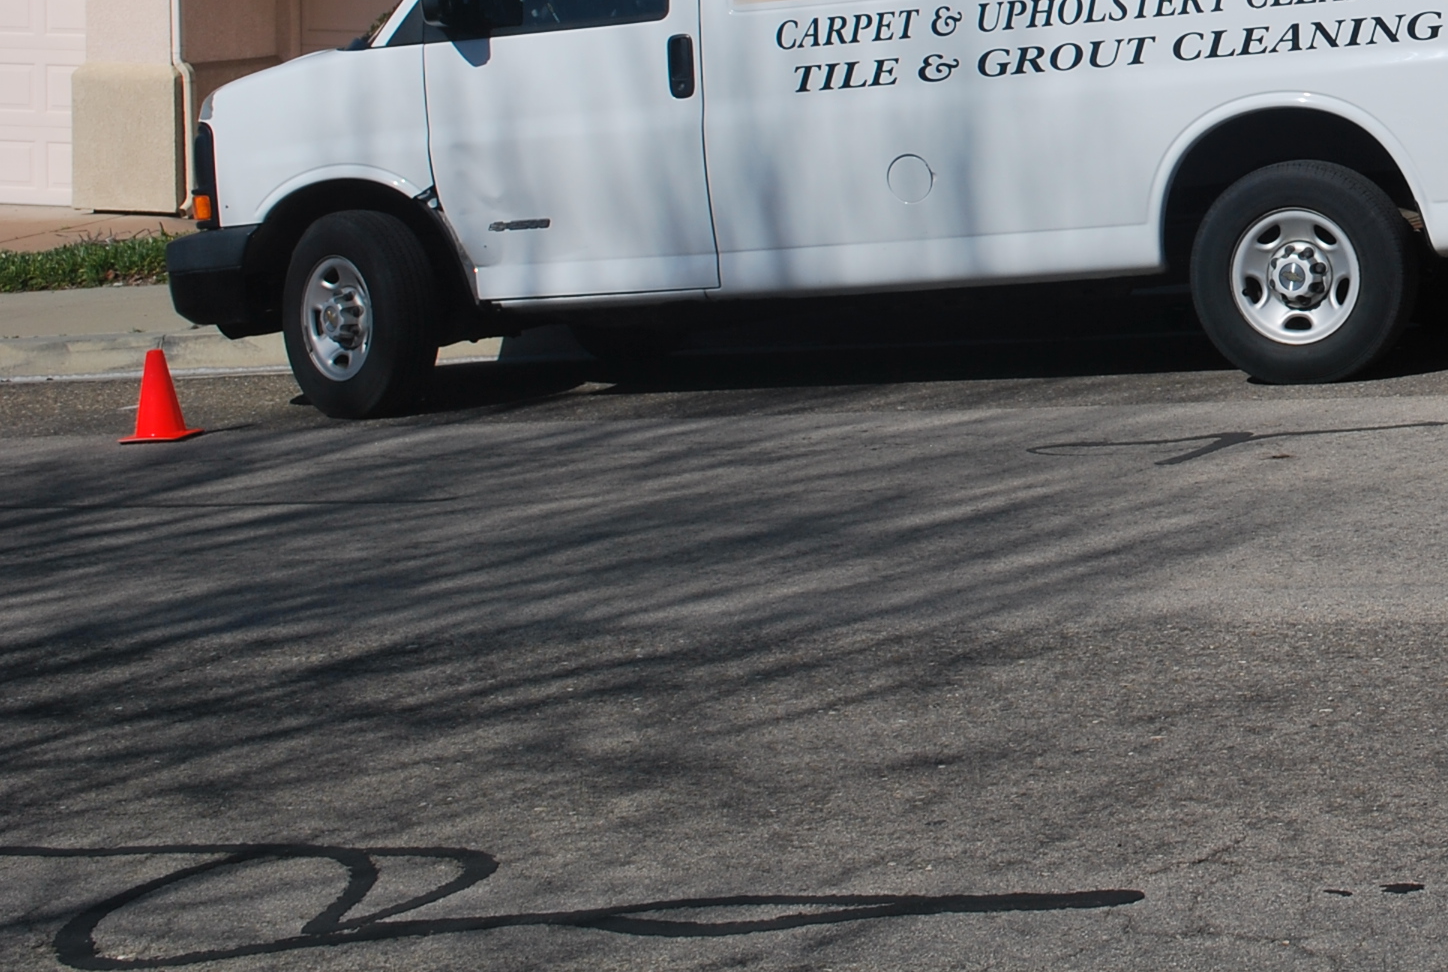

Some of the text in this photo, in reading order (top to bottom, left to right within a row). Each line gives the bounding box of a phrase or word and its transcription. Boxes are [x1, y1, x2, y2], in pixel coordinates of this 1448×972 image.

[775, 8, 920, 50] CARPET
[931, 5, 963, 37] &
[793, 10, 1445, 94] TILE & GROUT CLEANING
